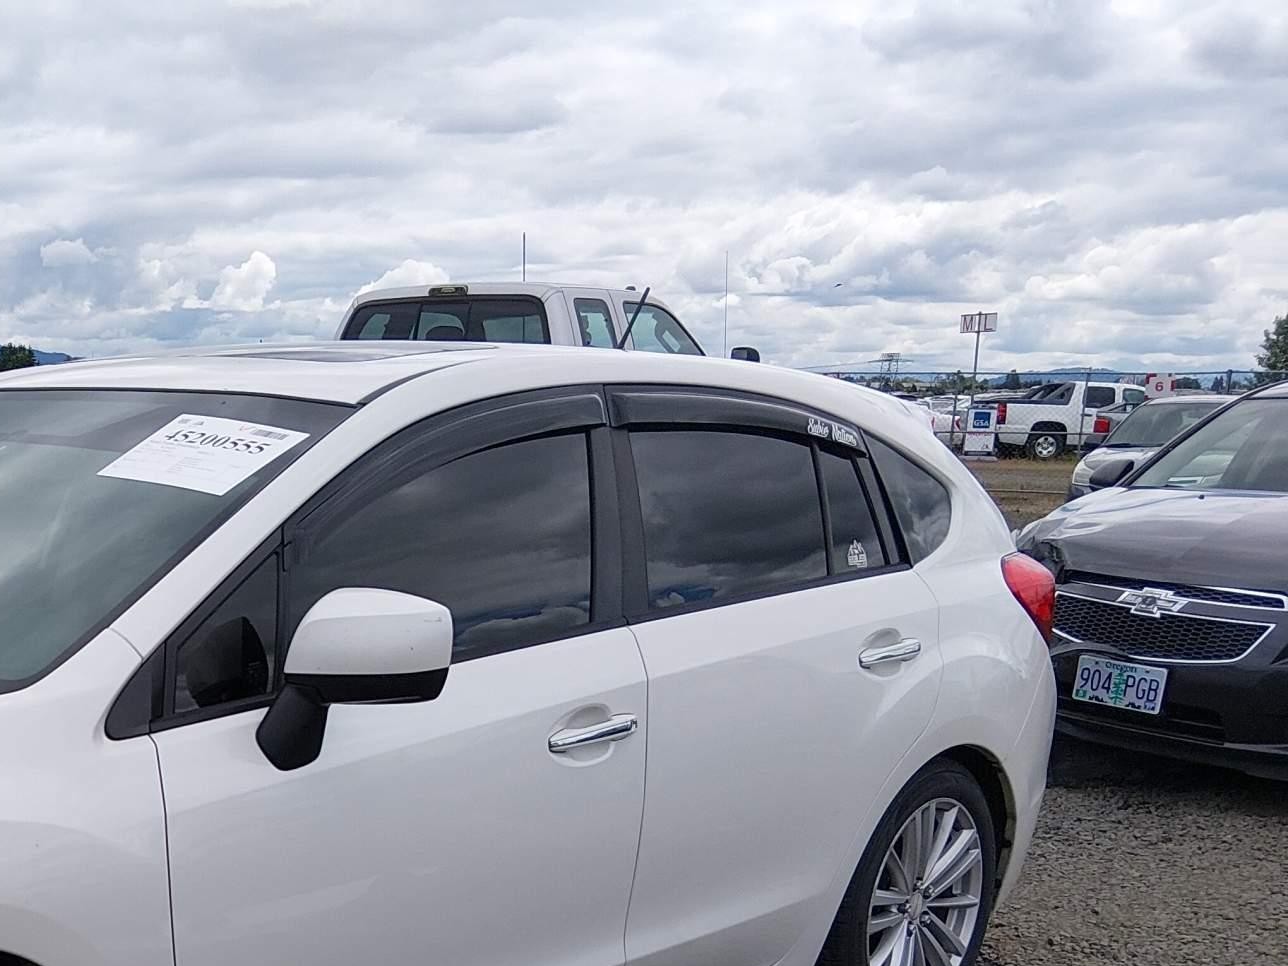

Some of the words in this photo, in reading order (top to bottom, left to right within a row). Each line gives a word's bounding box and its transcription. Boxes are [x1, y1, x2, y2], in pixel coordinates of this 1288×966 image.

[1155, 381, 1164, 392] 6
[973, 419, 990, 427] GSA
[164, 429, 272, 454] 45200555
[1105, 661, 1137, 674] Oregon
[1080, 667, 1113, 694] 904
[1124, 674, 1160, 702] PGB
